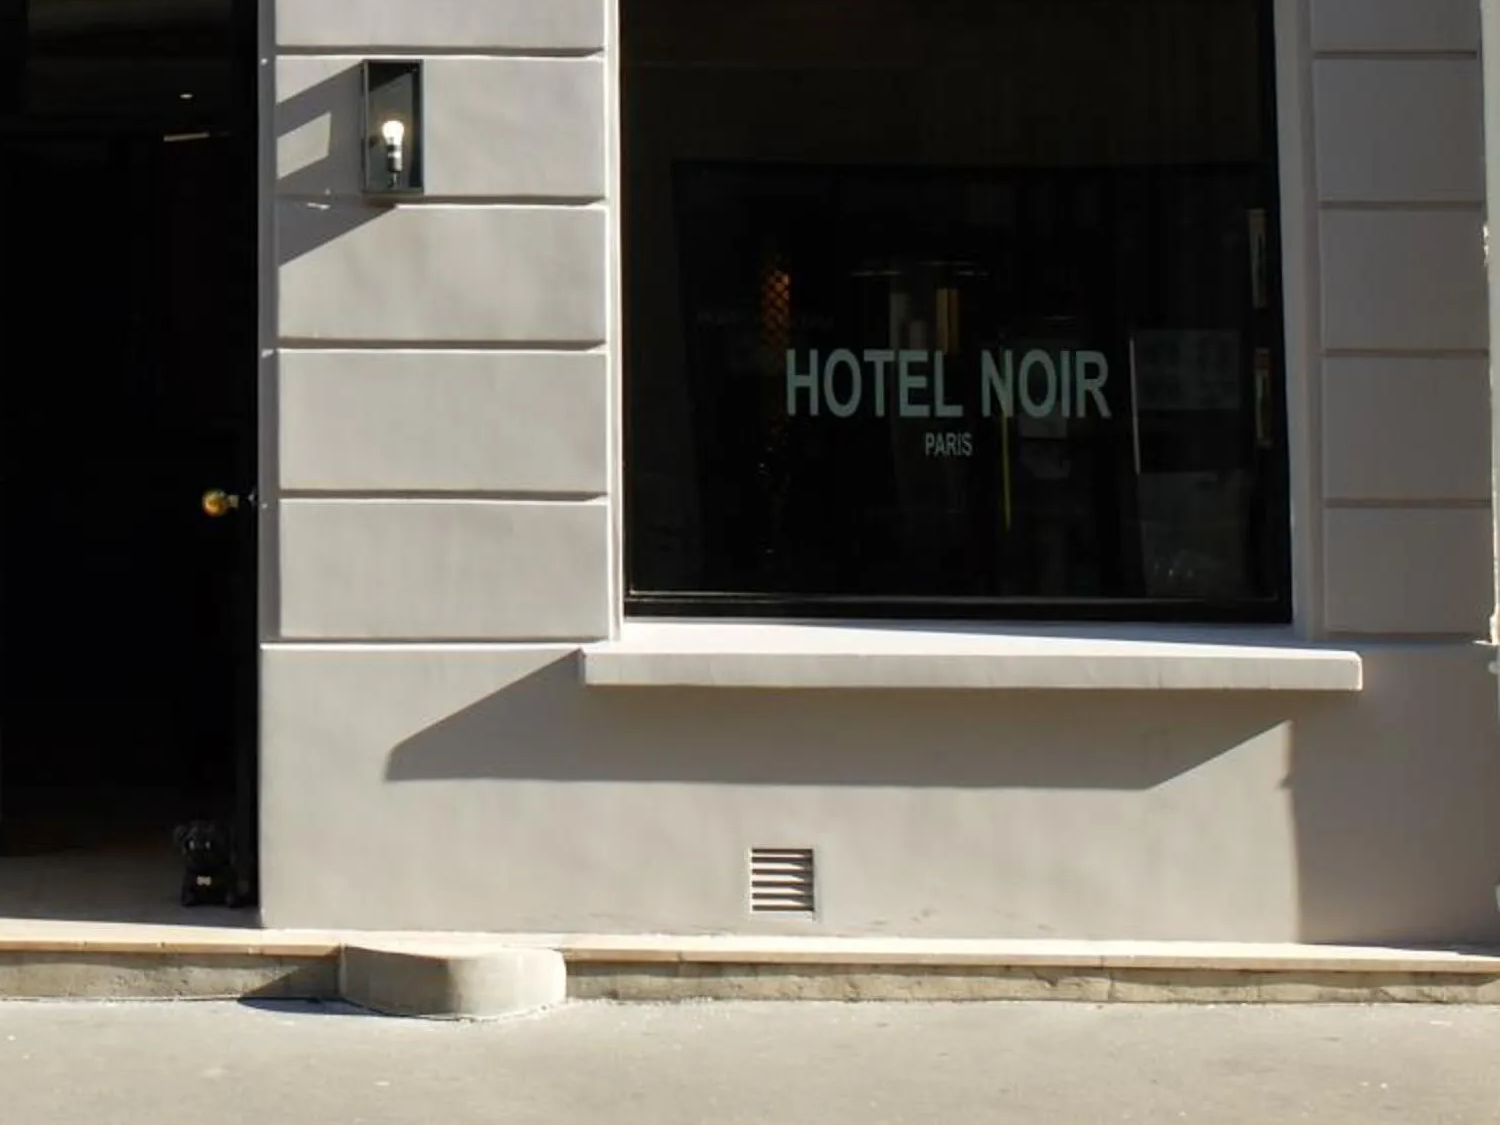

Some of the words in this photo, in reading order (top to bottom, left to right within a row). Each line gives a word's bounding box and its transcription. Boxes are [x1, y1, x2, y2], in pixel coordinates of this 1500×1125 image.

[786, 348, 964, 418] HOTEL
[981, 349, 1112, 418] NOIR
[924, 432, 973, 456] PARIS
